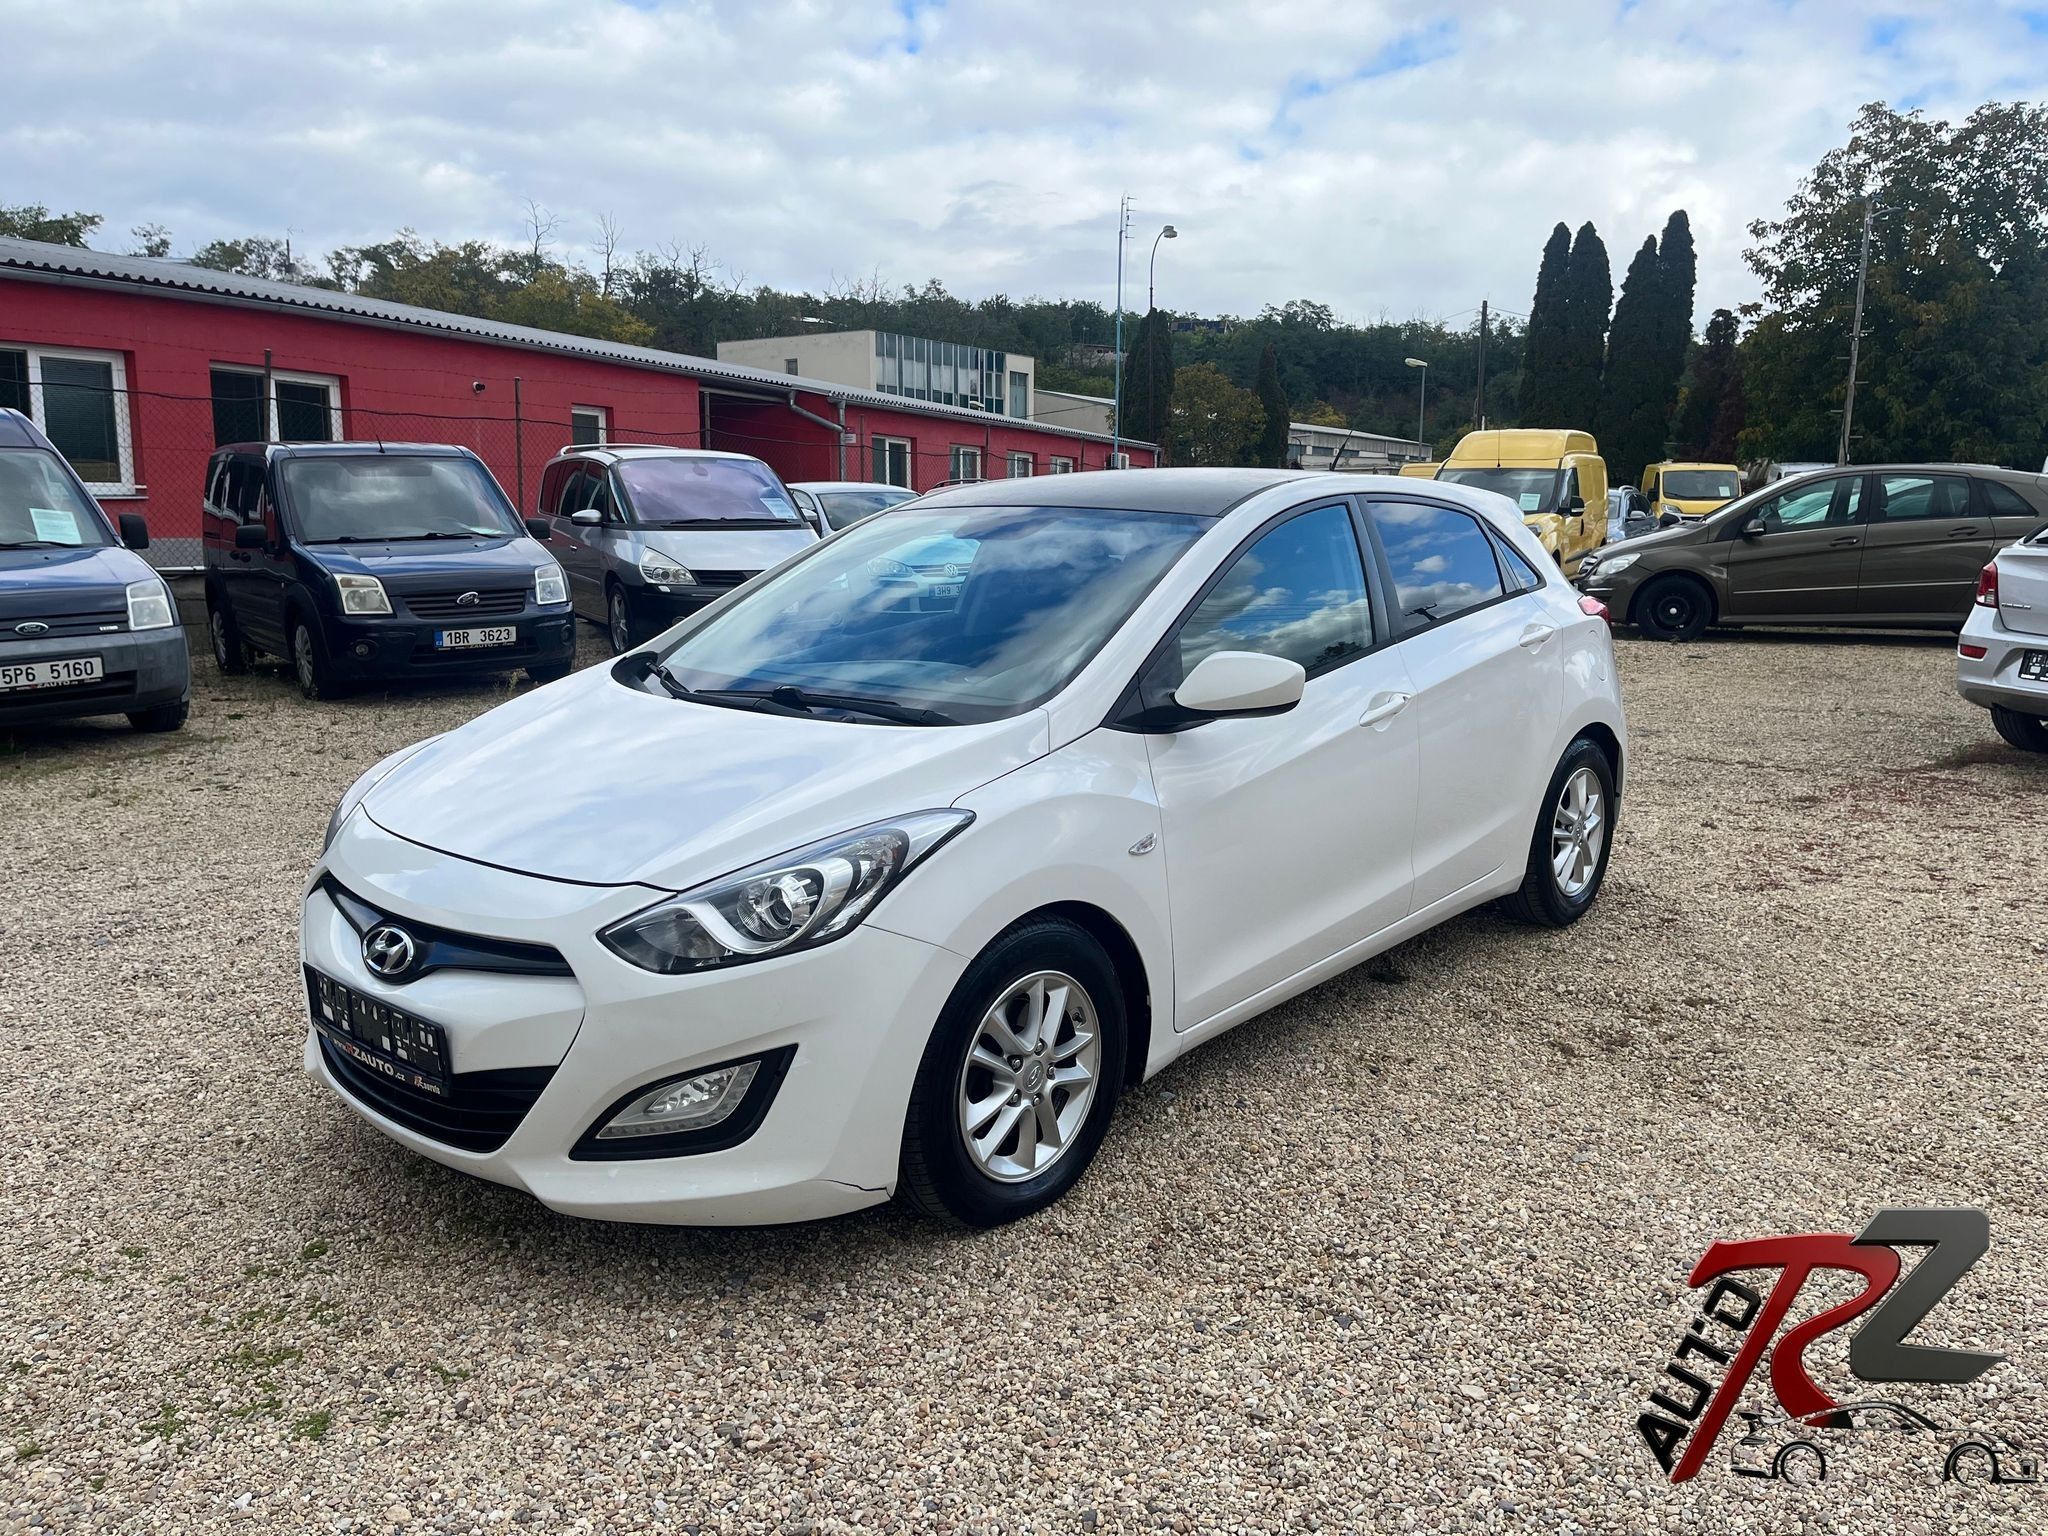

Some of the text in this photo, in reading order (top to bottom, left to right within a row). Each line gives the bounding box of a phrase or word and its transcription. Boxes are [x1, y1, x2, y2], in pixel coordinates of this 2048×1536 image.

[446, 628, 511, 645] 1BR 3623
[2, 660, 95, 685] 5P6 5160
